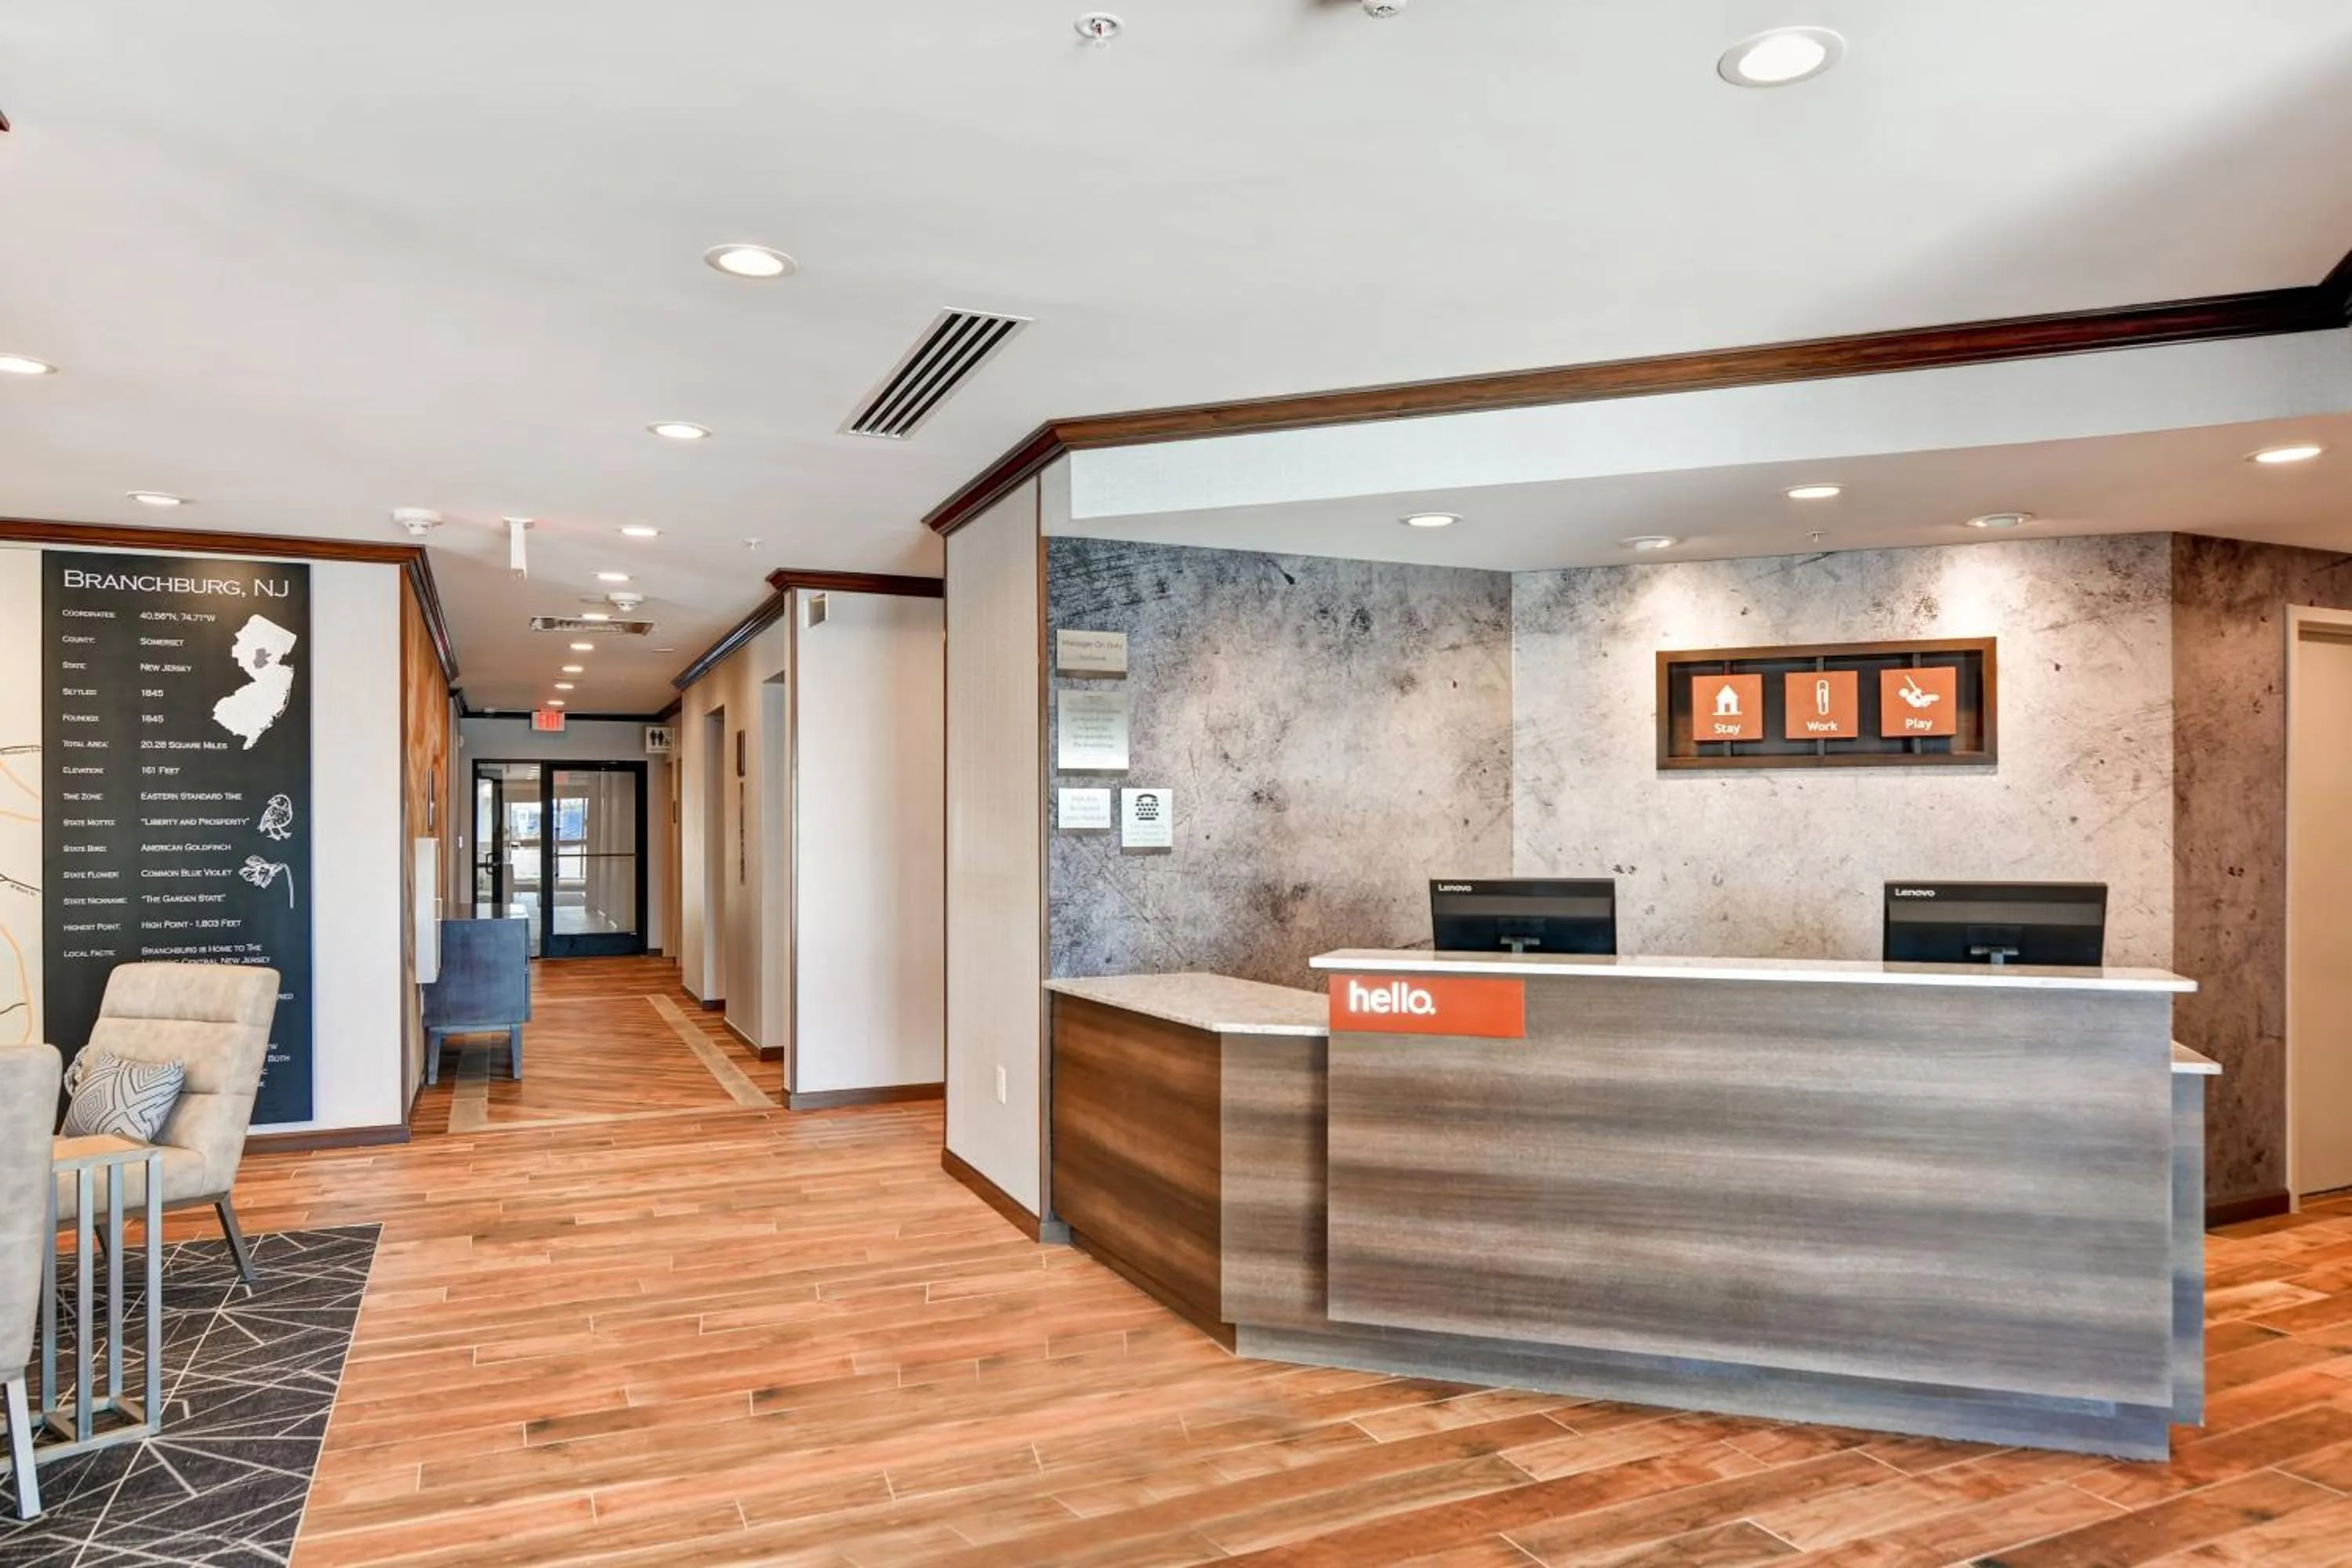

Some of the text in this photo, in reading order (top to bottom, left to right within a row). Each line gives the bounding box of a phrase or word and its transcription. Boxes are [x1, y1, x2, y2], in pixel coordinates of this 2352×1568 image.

[64, 569, 289, 598] BRANCHBURG, NJ
[140, 662, 161, 672] NEW
[141, 714, 164, 724] 1845
[1714, 722, 1740, 735] Stay
[1806, 722, 1838, 732] Work
[1905, 719, 1933, 731] Play
[62, 739, 85, 748] TOTAL
[202, 741, 228, 750] MILES
[141, 766, 180, 775] 161 FEET
[1438, 883, 1472, 892] Lenovo
[1895, 887, 1935, 897] Lenovo
[220, 918, 242, 927] FEET
[220, 956, 241, 966] NEW
[1348, 979, 1437, 1015] hello.
